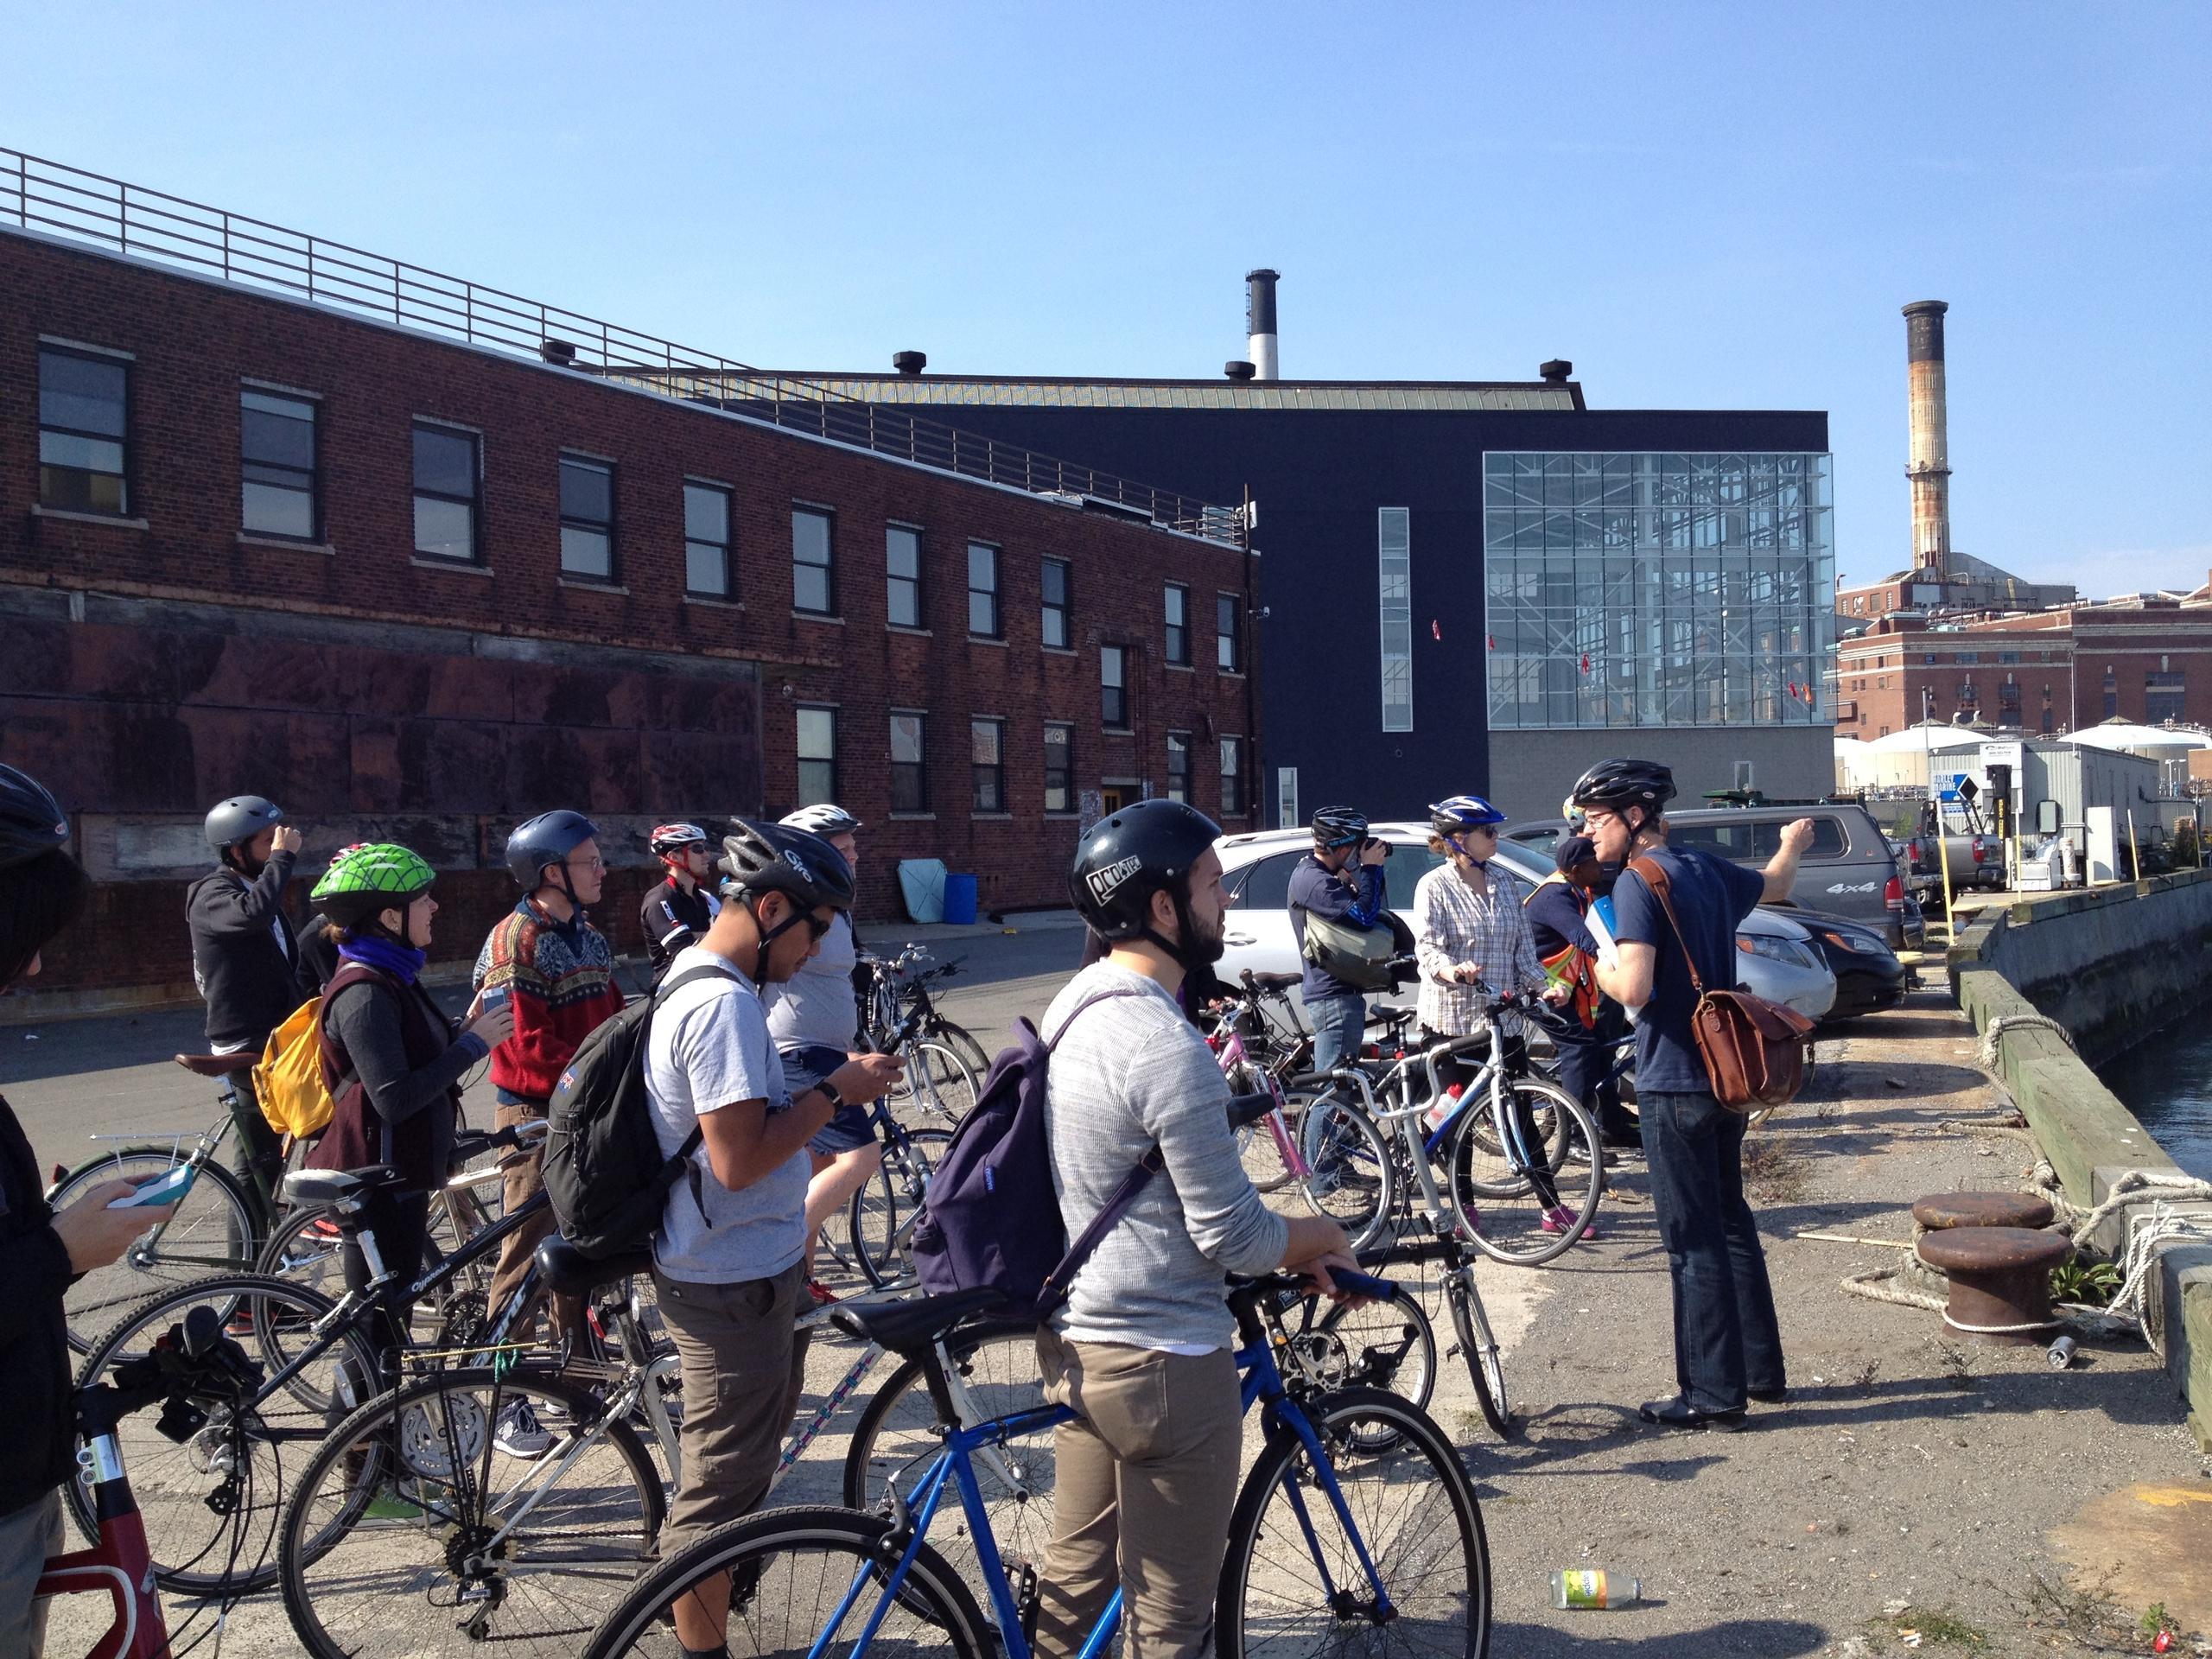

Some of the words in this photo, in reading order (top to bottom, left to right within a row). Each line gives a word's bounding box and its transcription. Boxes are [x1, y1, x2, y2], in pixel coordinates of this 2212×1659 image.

[784, 849, 812, 883] Giro
[1826, 881, 1878, 894] 4x4
[411, 1262, 451, 1292] Cypress
